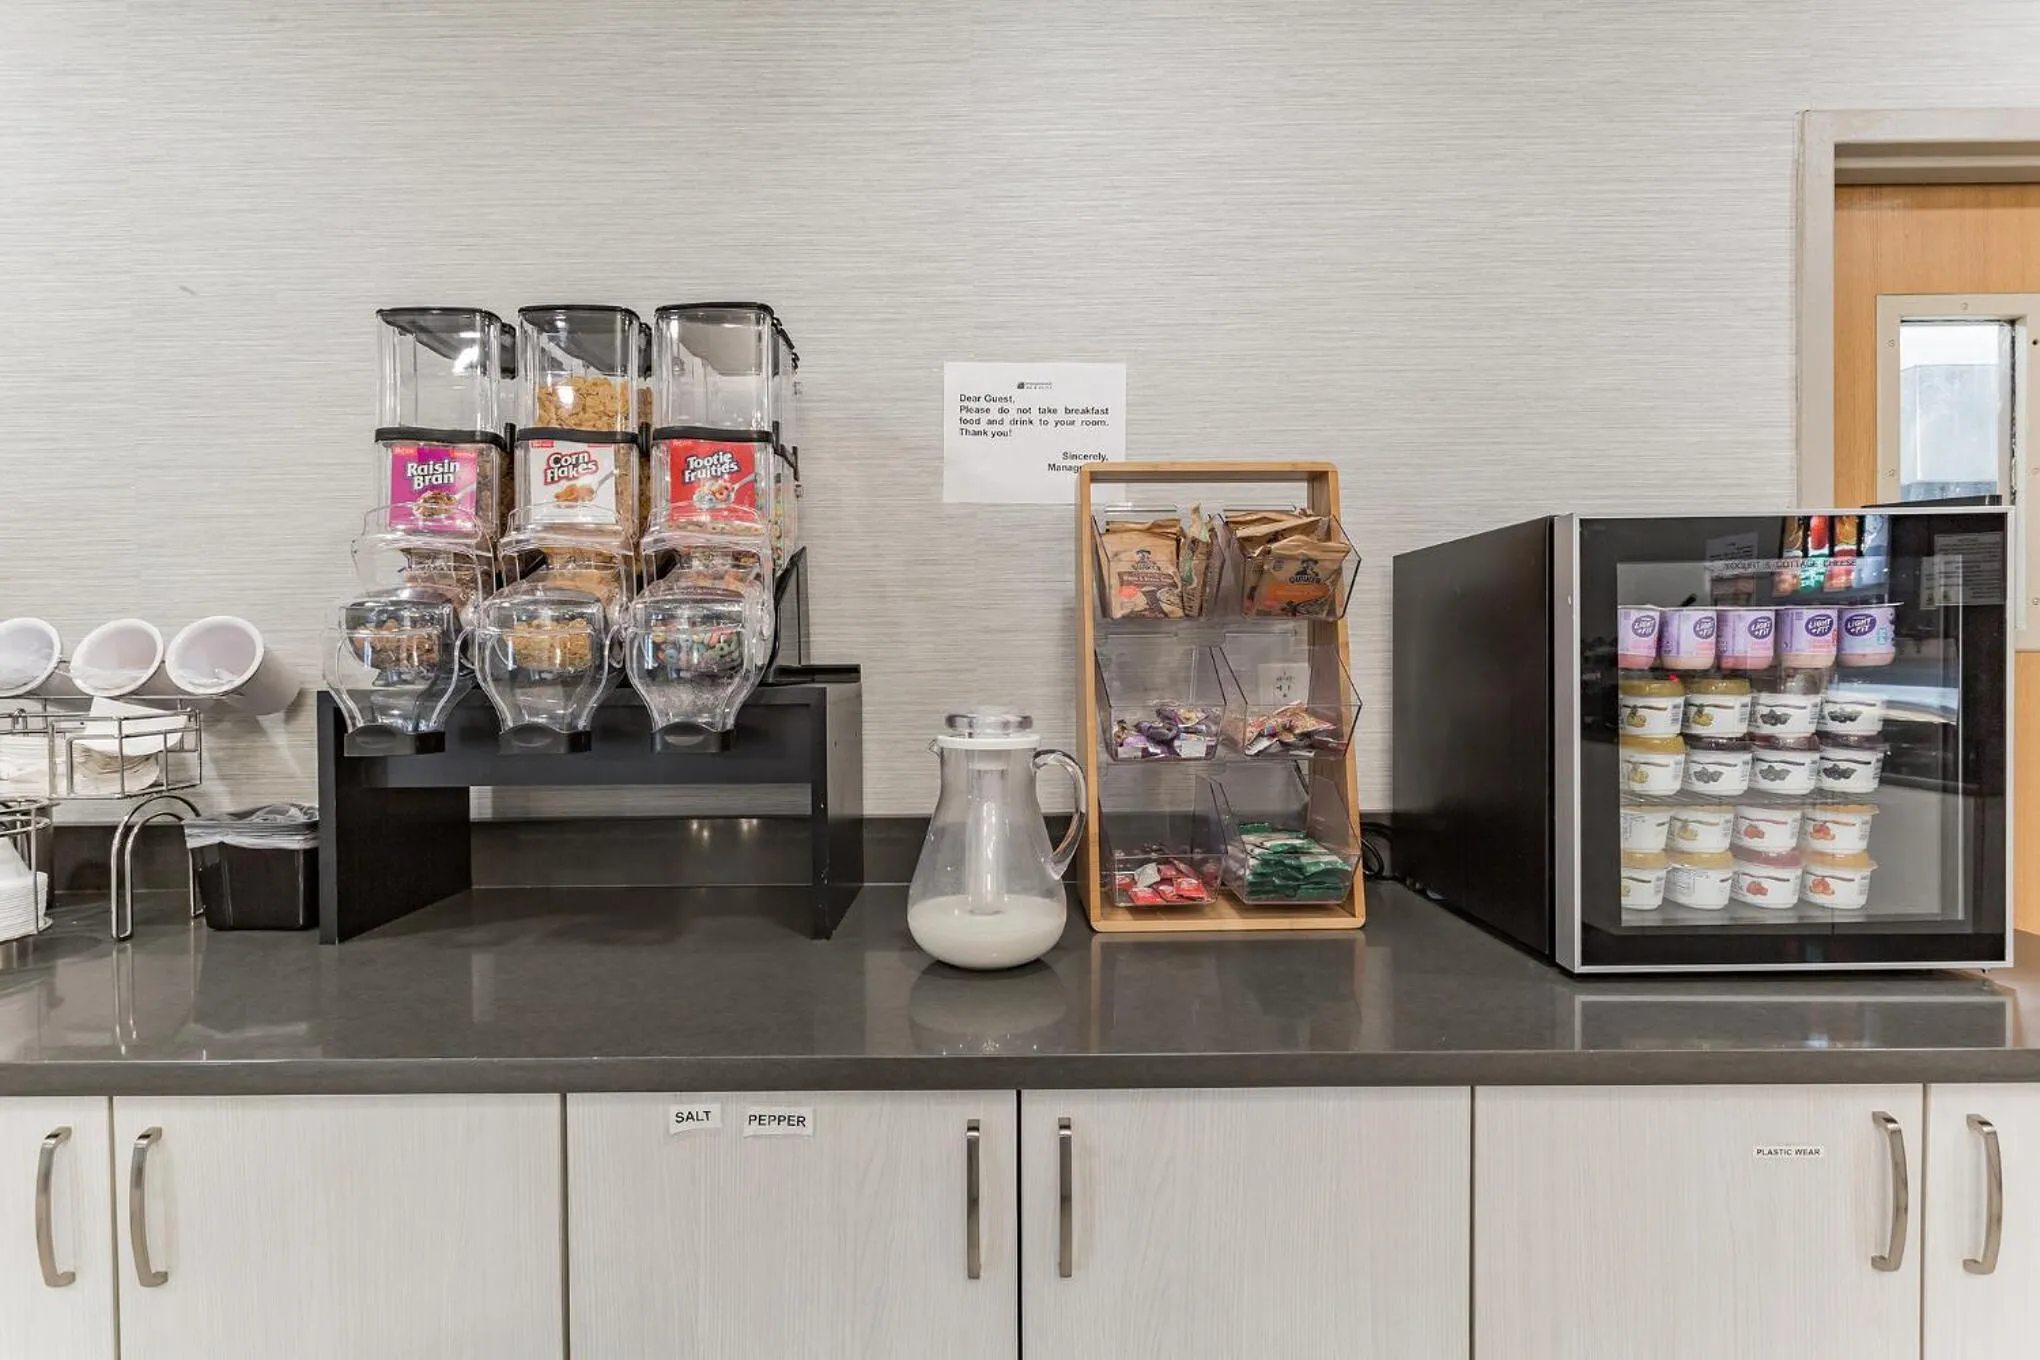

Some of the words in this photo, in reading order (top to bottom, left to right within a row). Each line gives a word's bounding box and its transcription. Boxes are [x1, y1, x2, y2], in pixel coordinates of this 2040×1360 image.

[959, 394, 981, 403] Dear
[984, 394, 1015, 404] Guest,
[959, 406, 991, 415] Please
[998, 406, 1010, 415] do
[1016, 406, 1032, 415] not
[1038, 406, 1058, 415] take
[1064, 406, 1109, 415] breakfast
[959, 417, 981, 426] food
[986, 417, 1004, 426] and
[1009, 417, 1034, 426] drink
[1039, 417, 1049, 426] to
[1054, 419, 1076, 429] your
[1081, 419, 1109, 427] room.
[959, 428, 988, 437] Thank
[991, 428, 1013, 439] you!
[549, 452, 588, 468] Corn
[686, 451, 733, 470] Tootie
[1062, 451, 1109, 462] Sincerely,
[407, 459, 459, 477] Raisin
[683, 461, 739, 483] Fruities
[413, 472, 455, 490] Bran
[1776, 560, 1816, 569] COTTAGE
[1809, 618, 1832, 628] LIGHT
[1847, 618, 1872, 628] LIGHT
[675, 1110, 712, 1124] SALT
[748, 1114, 806, 1127] PEPPER
[1756, 1148, 1792, 1156] PLASTIC
[1794, 1148, 1821, 1156] WEAR
